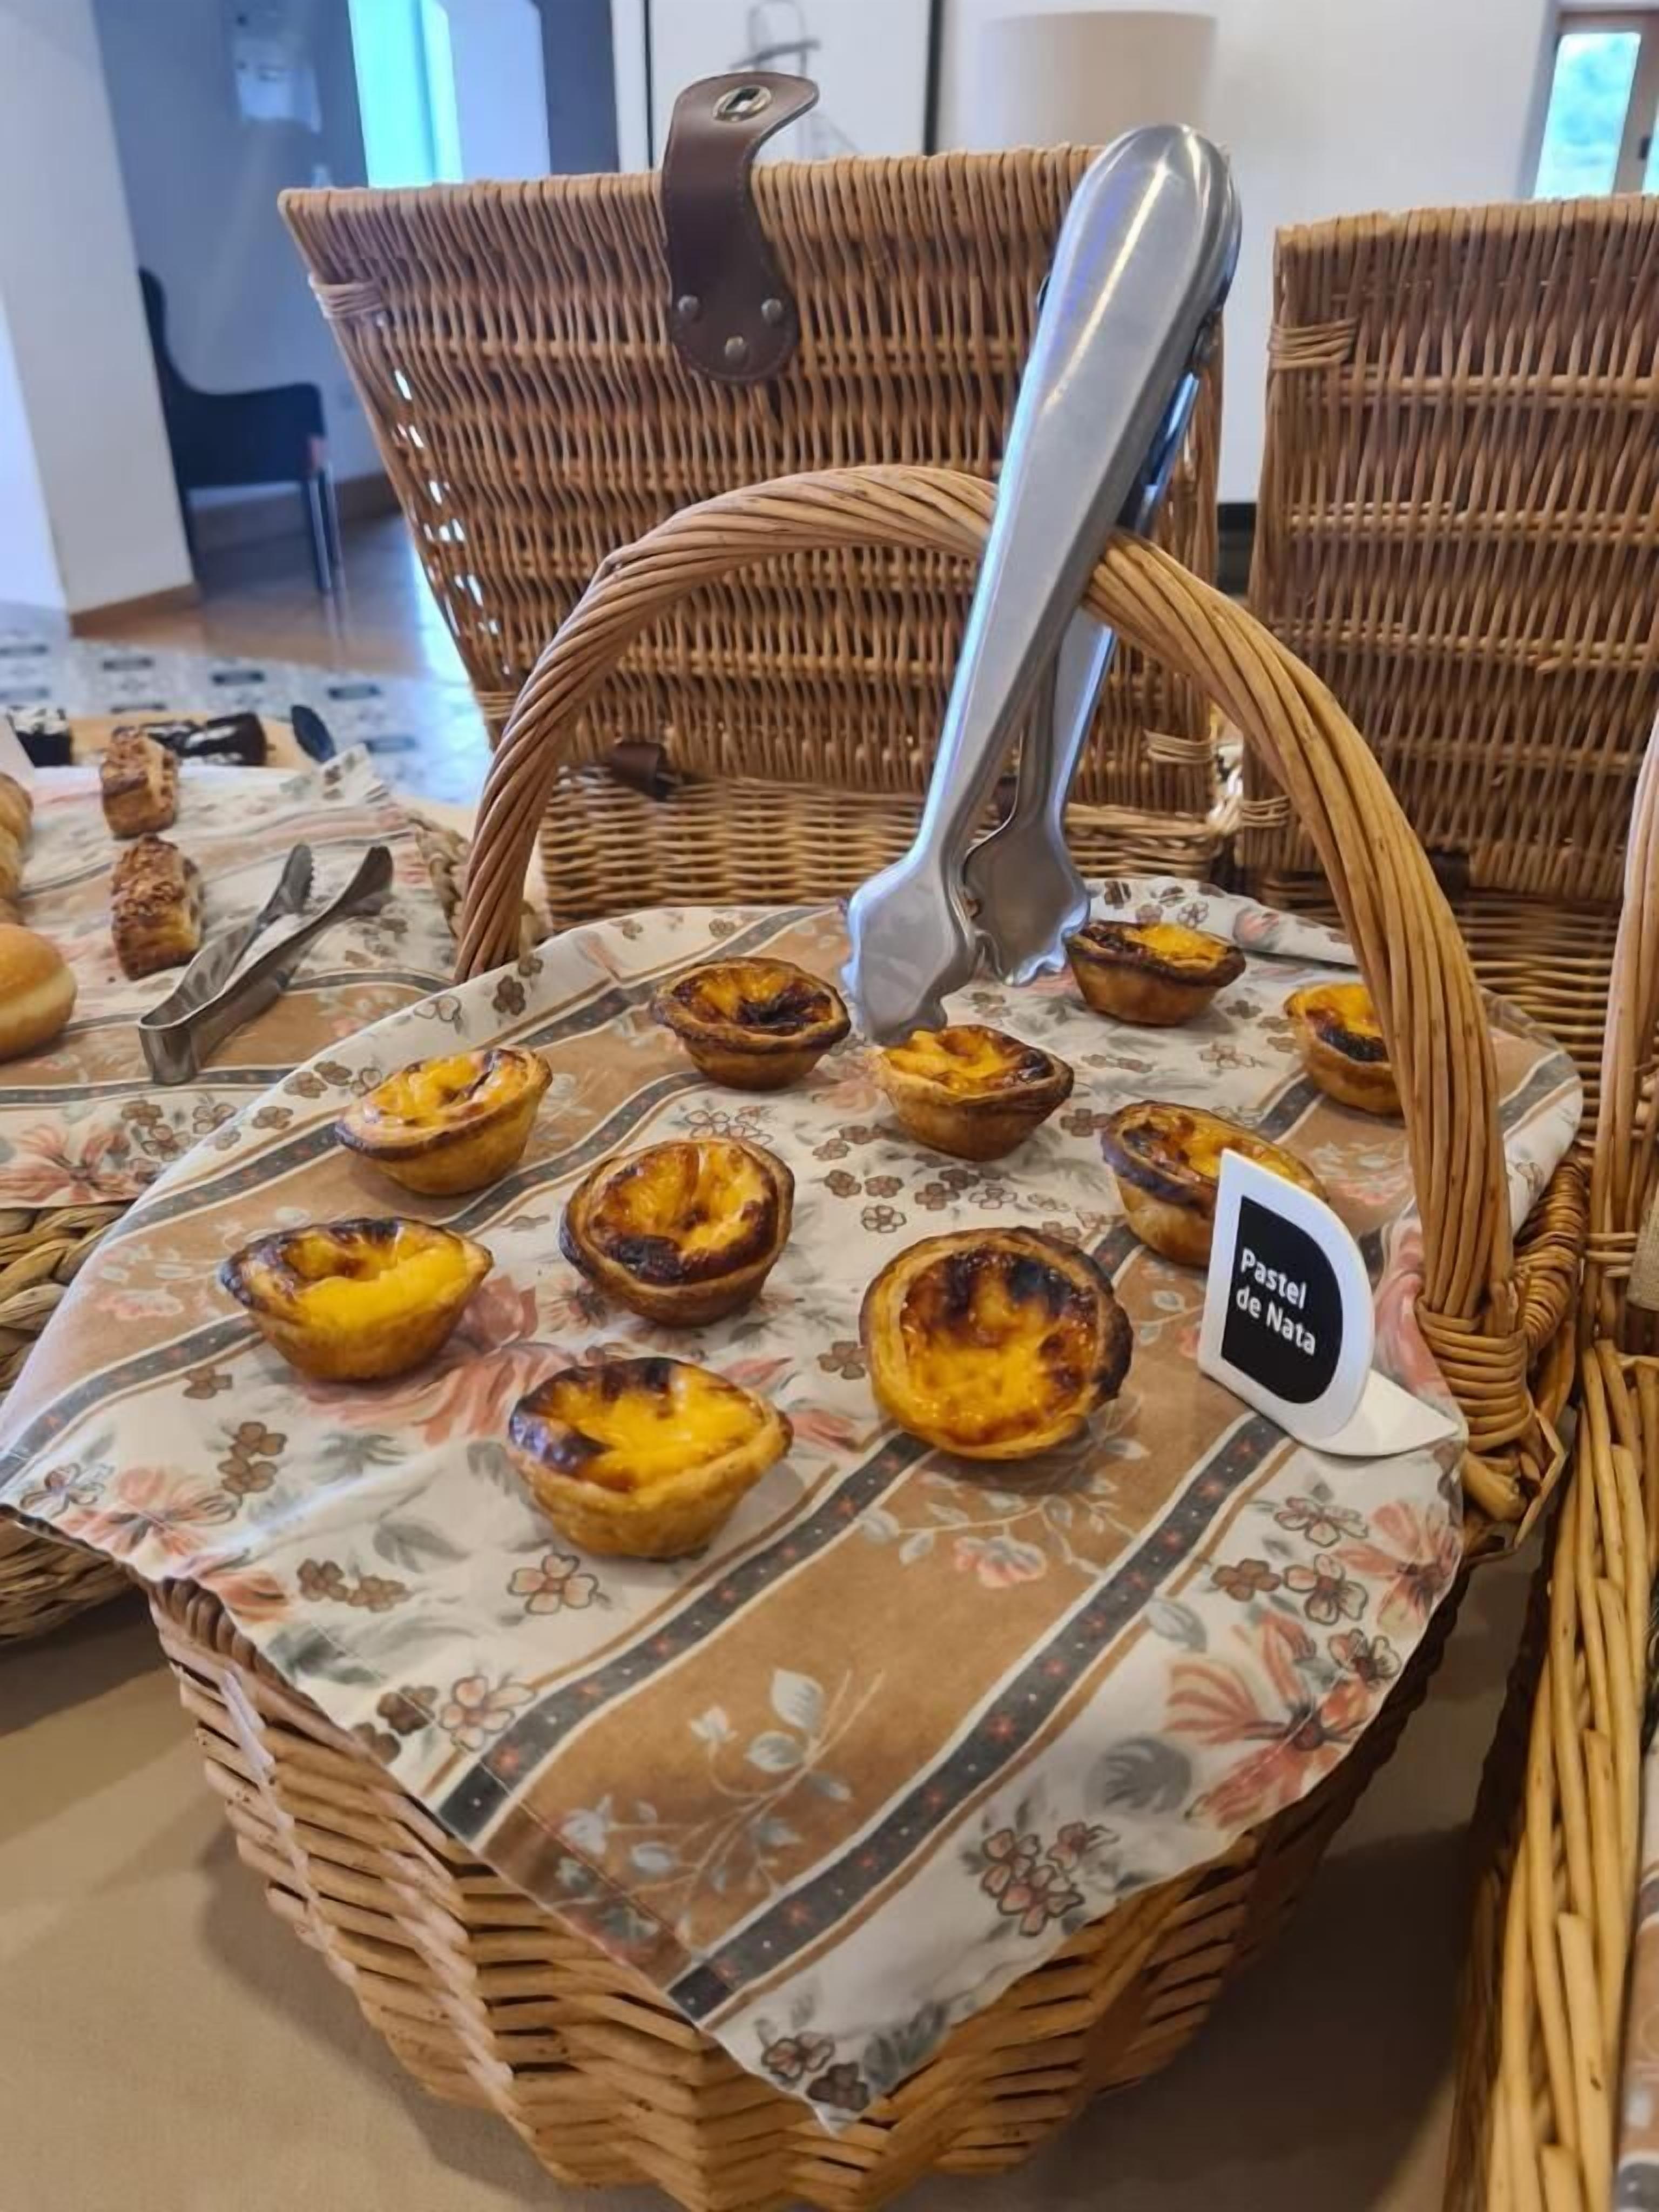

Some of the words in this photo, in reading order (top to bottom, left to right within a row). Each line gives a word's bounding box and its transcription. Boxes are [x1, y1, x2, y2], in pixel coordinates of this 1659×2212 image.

[1241, 1247, 1306, 1310] Pastel
[1236, 1285, 1262, 1319] de
[1266, 1301, 1316, 1355] Nata
